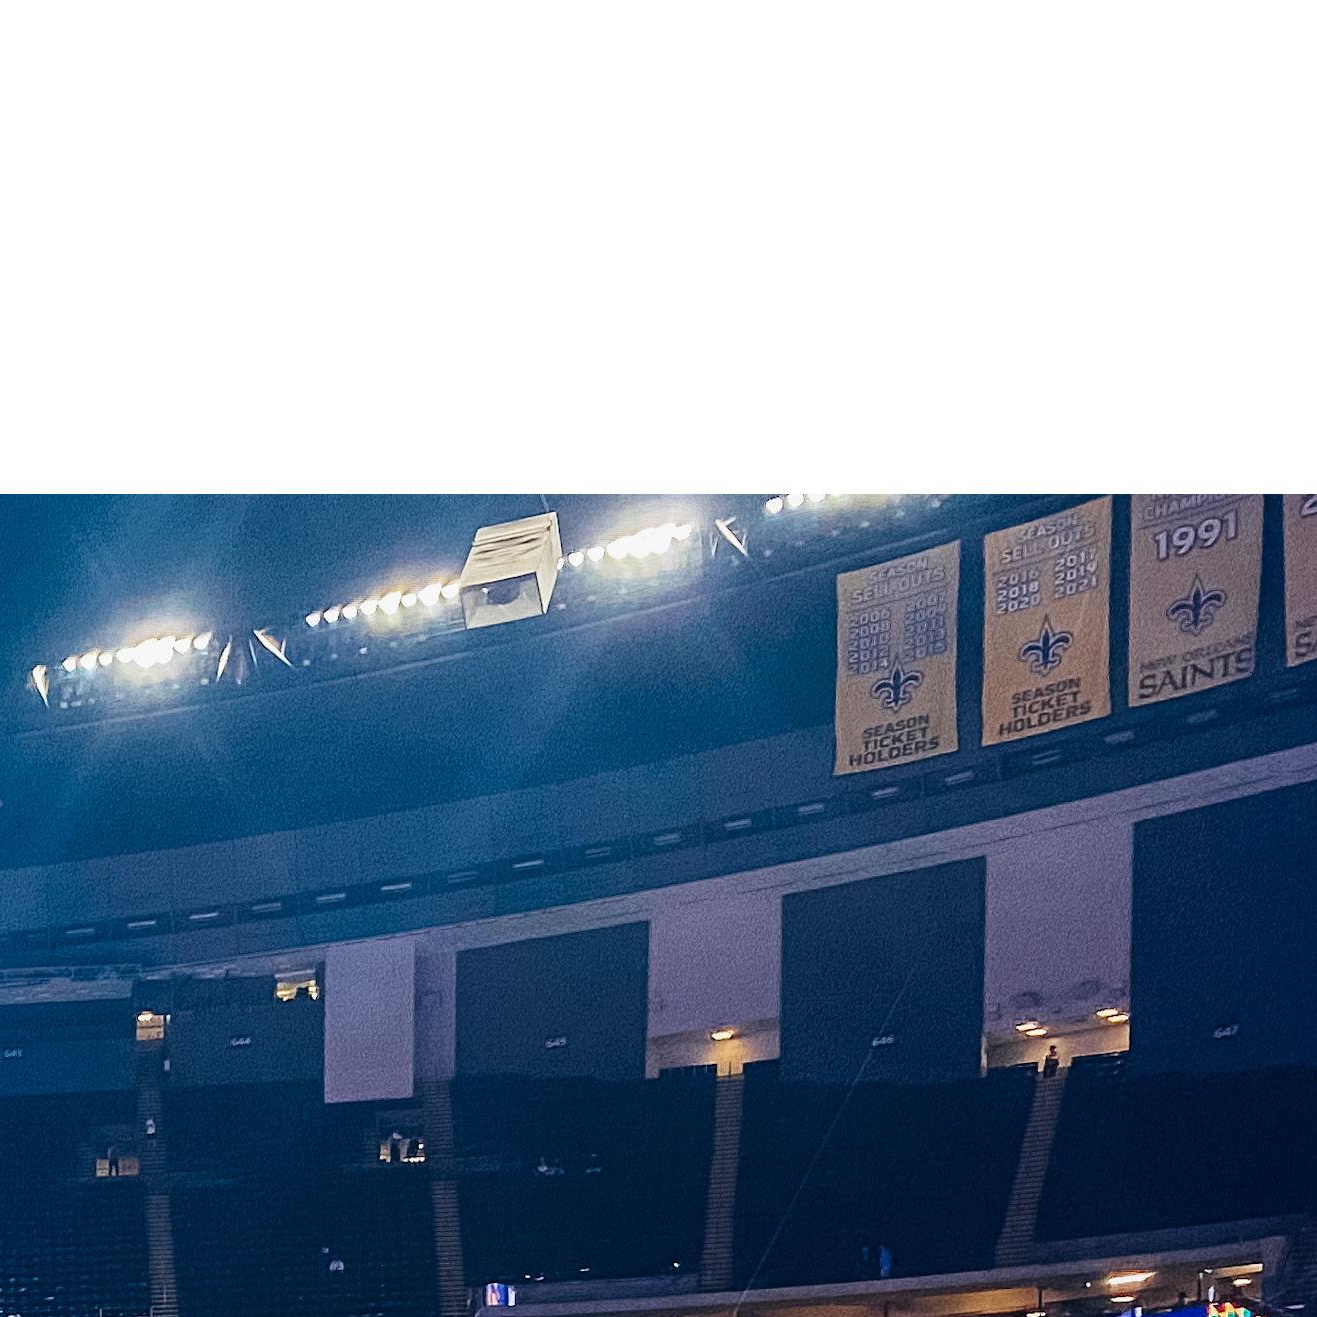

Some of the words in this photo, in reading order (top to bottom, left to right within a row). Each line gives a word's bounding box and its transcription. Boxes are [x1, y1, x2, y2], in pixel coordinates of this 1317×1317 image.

[1154, 509, 1239, 562] 1991
[997, 584, 1040, 602] 2018
[1139, 649, 1255, 700] SAINTS
[1012, 677, 1081, 705] SEASON
[1012, 691, 1081, 720] TICKET
[863, 714, 929, 741] SEASON
[999, 700, 1092, 736] HOLDERS
[849, 737, 940, 767] HOLDERS
[863, 727, 929, 752] TICKET
